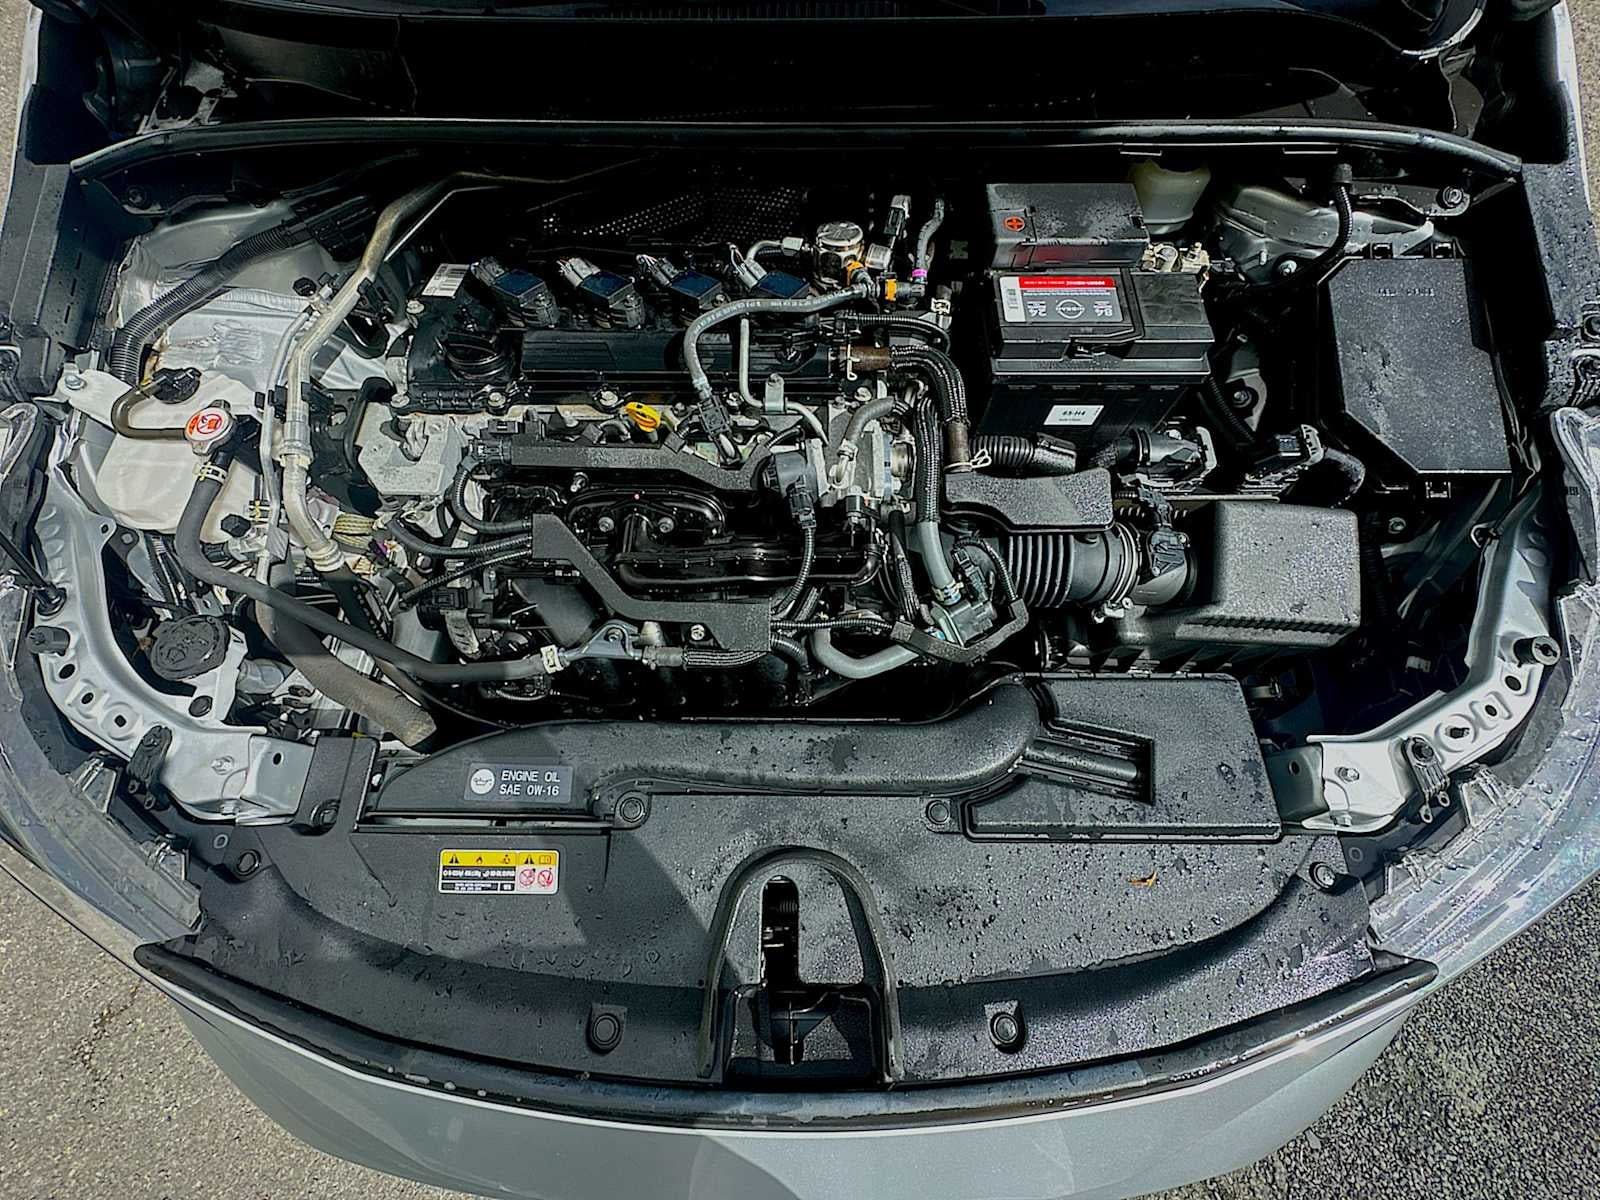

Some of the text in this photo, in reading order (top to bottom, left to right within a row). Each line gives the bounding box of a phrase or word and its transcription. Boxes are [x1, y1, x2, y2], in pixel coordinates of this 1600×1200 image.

[501, 770, 561, 783] ENGINE OIL
[499, 784, 560, 796] SAE 0W-16
